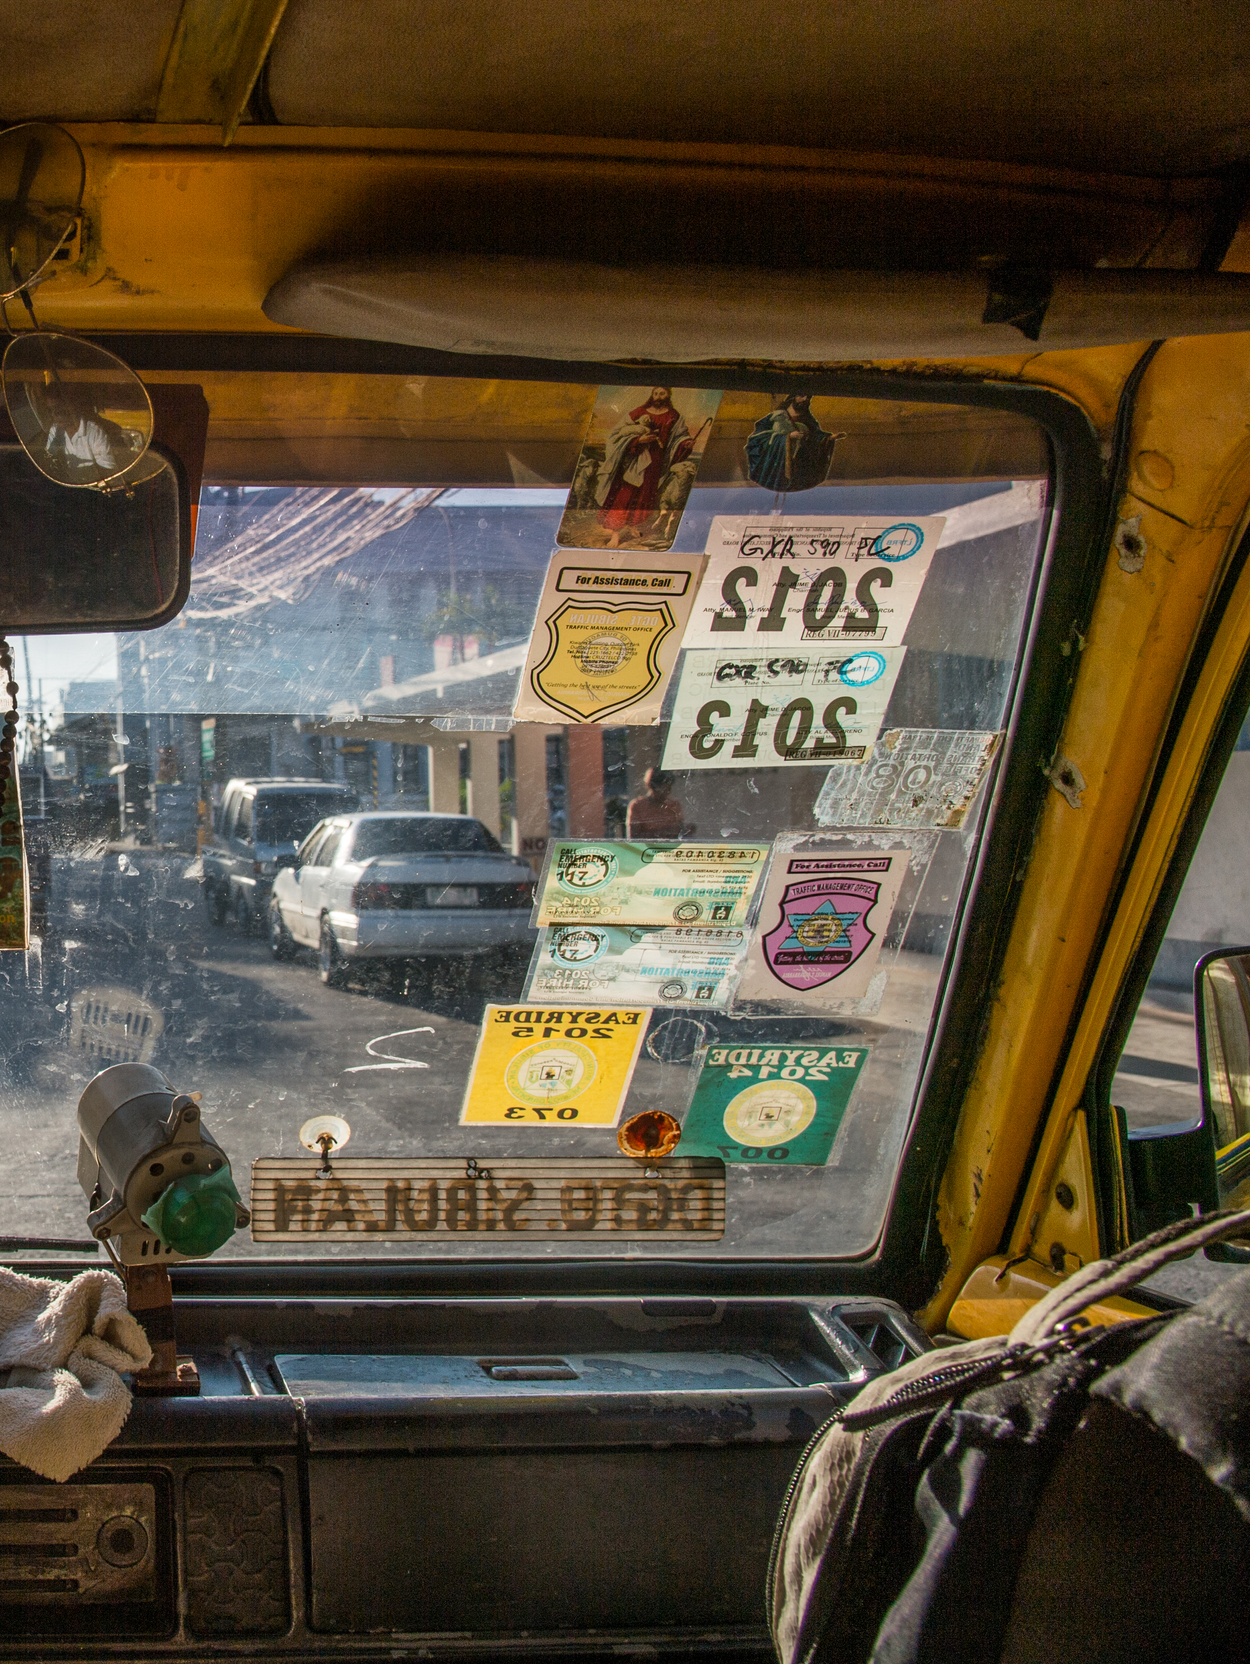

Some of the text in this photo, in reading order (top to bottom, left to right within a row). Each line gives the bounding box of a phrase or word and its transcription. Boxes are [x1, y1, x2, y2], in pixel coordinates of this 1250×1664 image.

[807, 538, 841, 558] 590
[575, 575, 592, 585] For
[592, 576, 650, 588] Assistance,
[651, 578, 672, 588] Call
[805, 629, 825, 639] REG
[559, 854, 616, 863] EMERGENCY
[792, 882, 875, 896] TRAFFIC MANAGEMENT OFFICE
